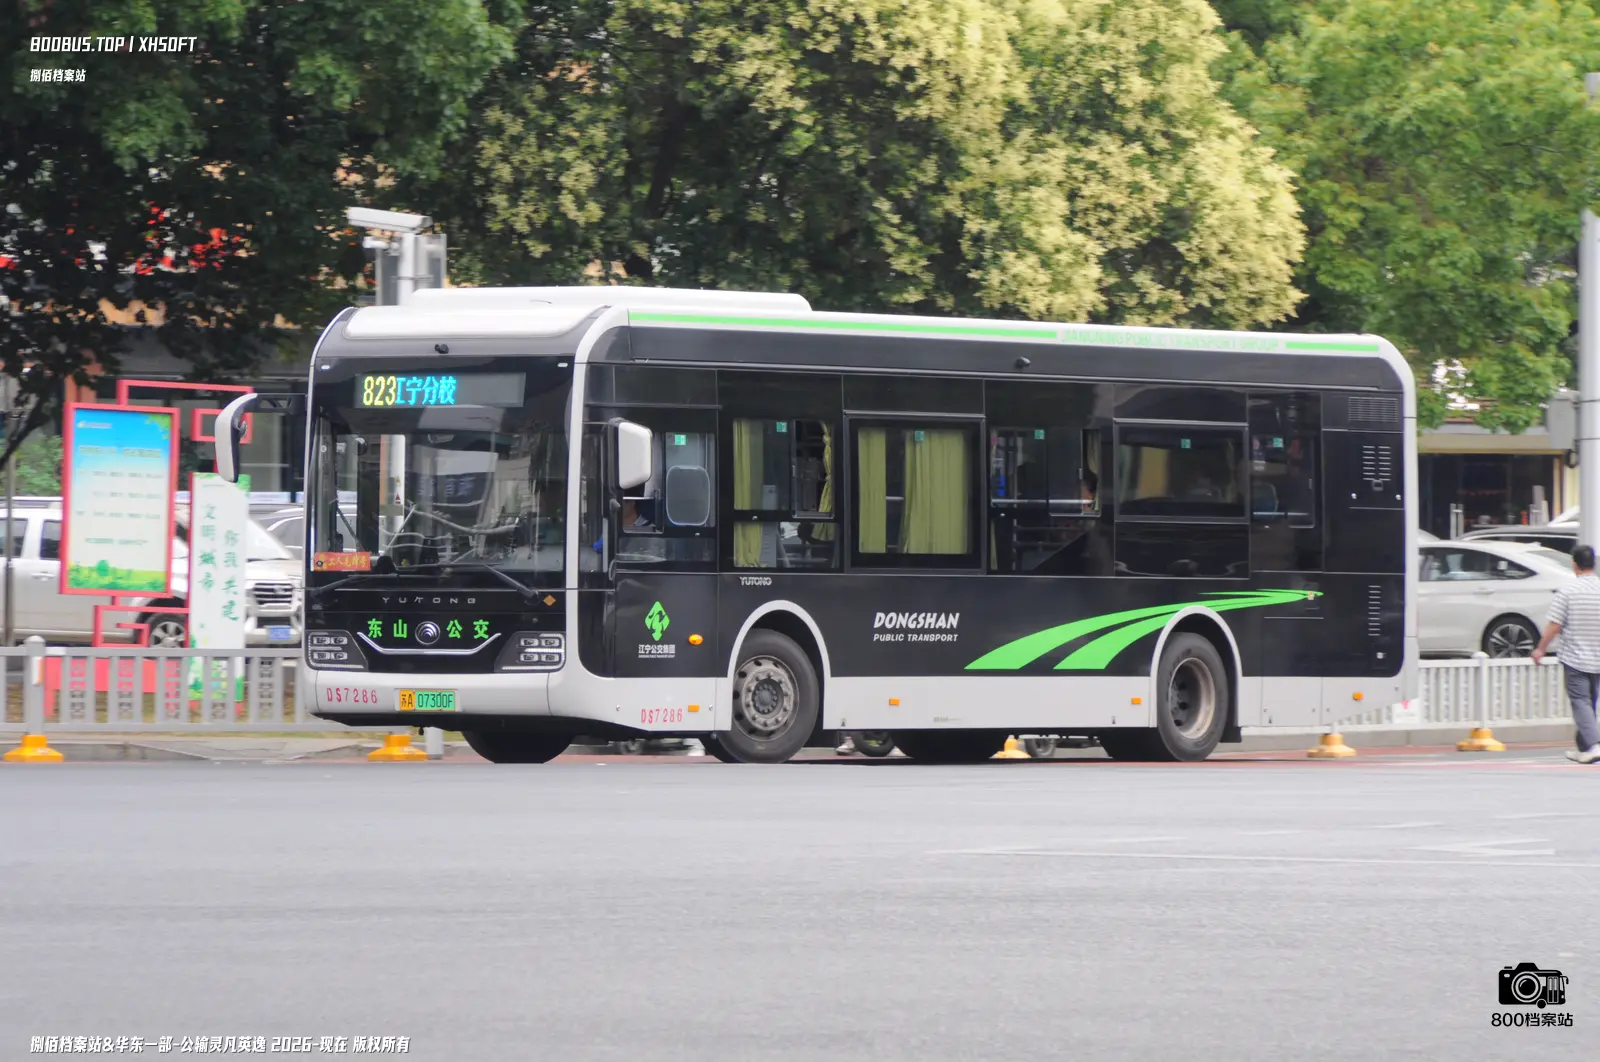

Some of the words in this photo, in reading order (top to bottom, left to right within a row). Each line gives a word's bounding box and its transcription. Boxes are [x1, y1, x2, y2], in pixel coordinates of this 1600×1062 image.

[363, 375, 396, 406] 823
[739, 576, 773, 586] YUTONG
[382, 596, 476, 604] YUTONG
[873, 611, 960, 629] DONGSHAN
[873, 633, 905, 642] PUBLIC
[907, 633, 959, 642] TRANSPORT
[326, 687, 378, 704] DS7286
[640, 708, 683, 724] DS7286
